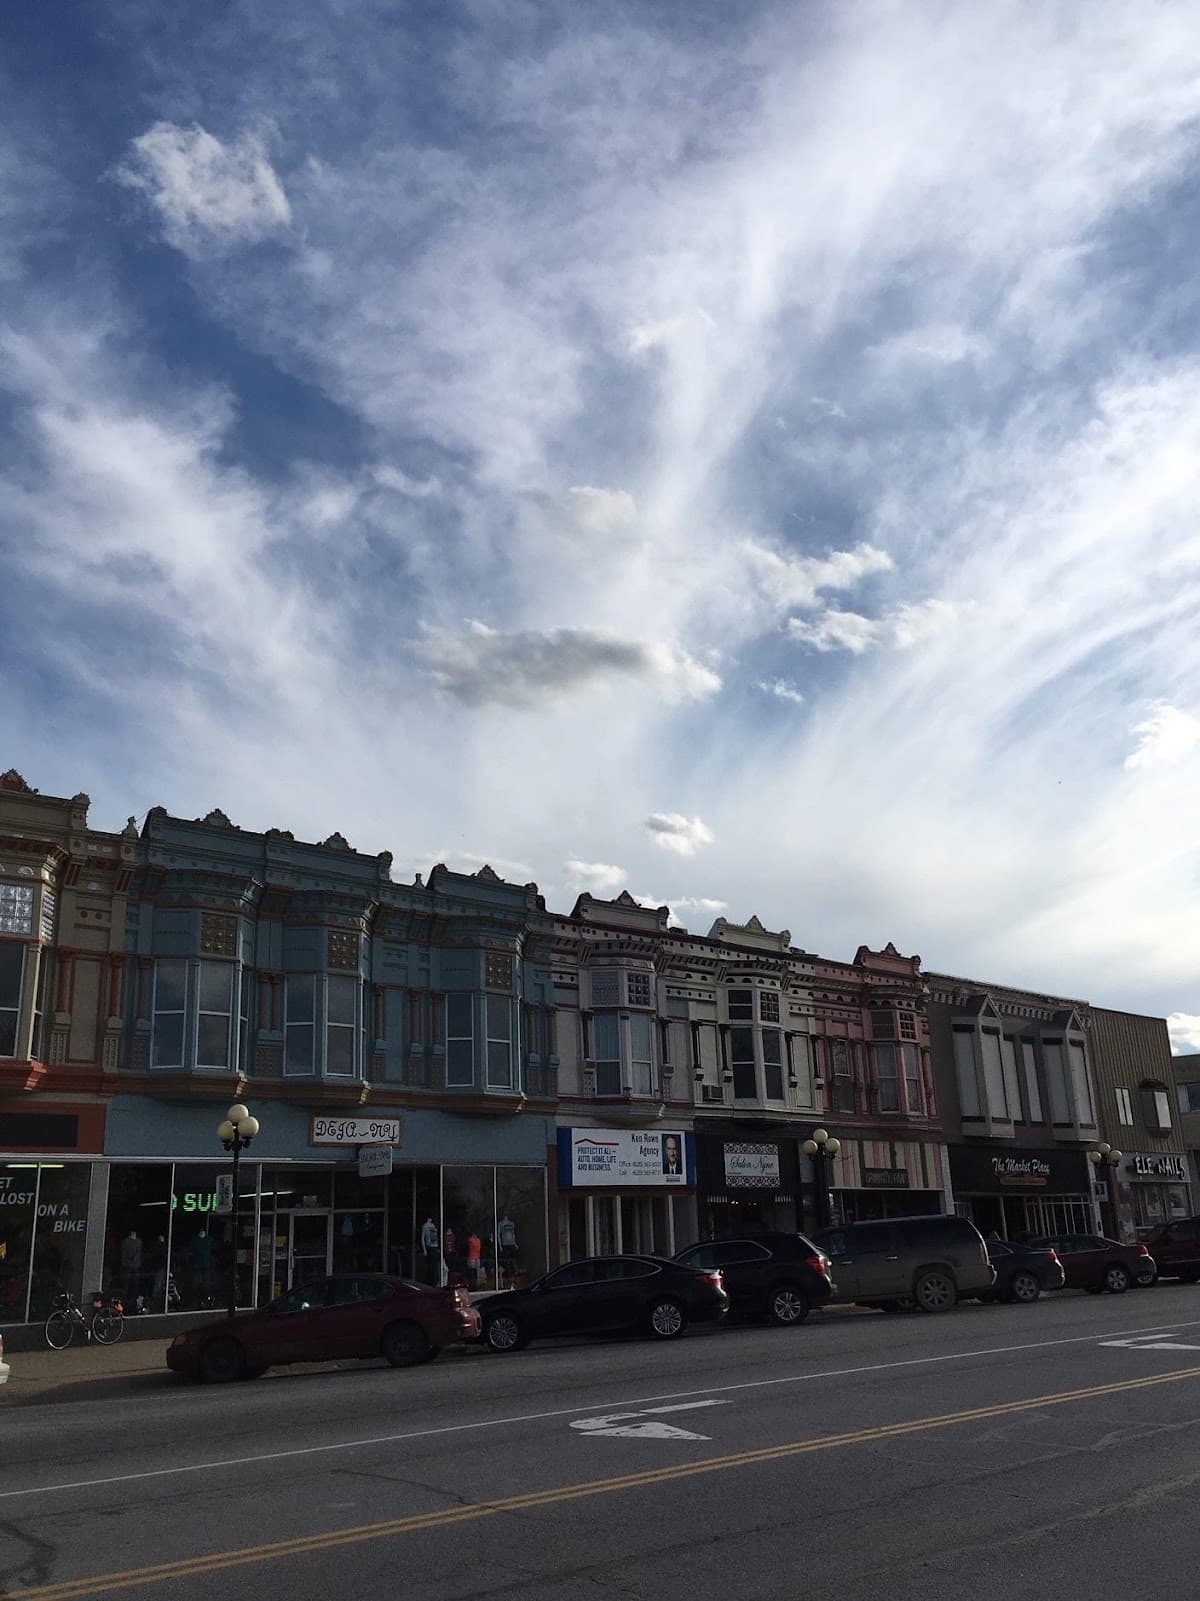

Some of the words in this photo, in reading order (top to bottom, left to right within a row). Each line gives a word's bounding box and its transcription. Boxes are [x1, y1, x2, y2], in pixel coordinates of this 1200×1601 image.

[640, 1145, 659, 1157] Agency
[992, 1157, 1005, 1175] The
[1005, 1157, 1031, 1173] Market
[1156, 1156, 1185, 1180] NAILS
[0, 1192, 34, 1205] LOST
[38, 1204, 57, 1217] ON
[59, 1204, 69, 1216] A
[53, 1220, 86, 1233] BIKE
